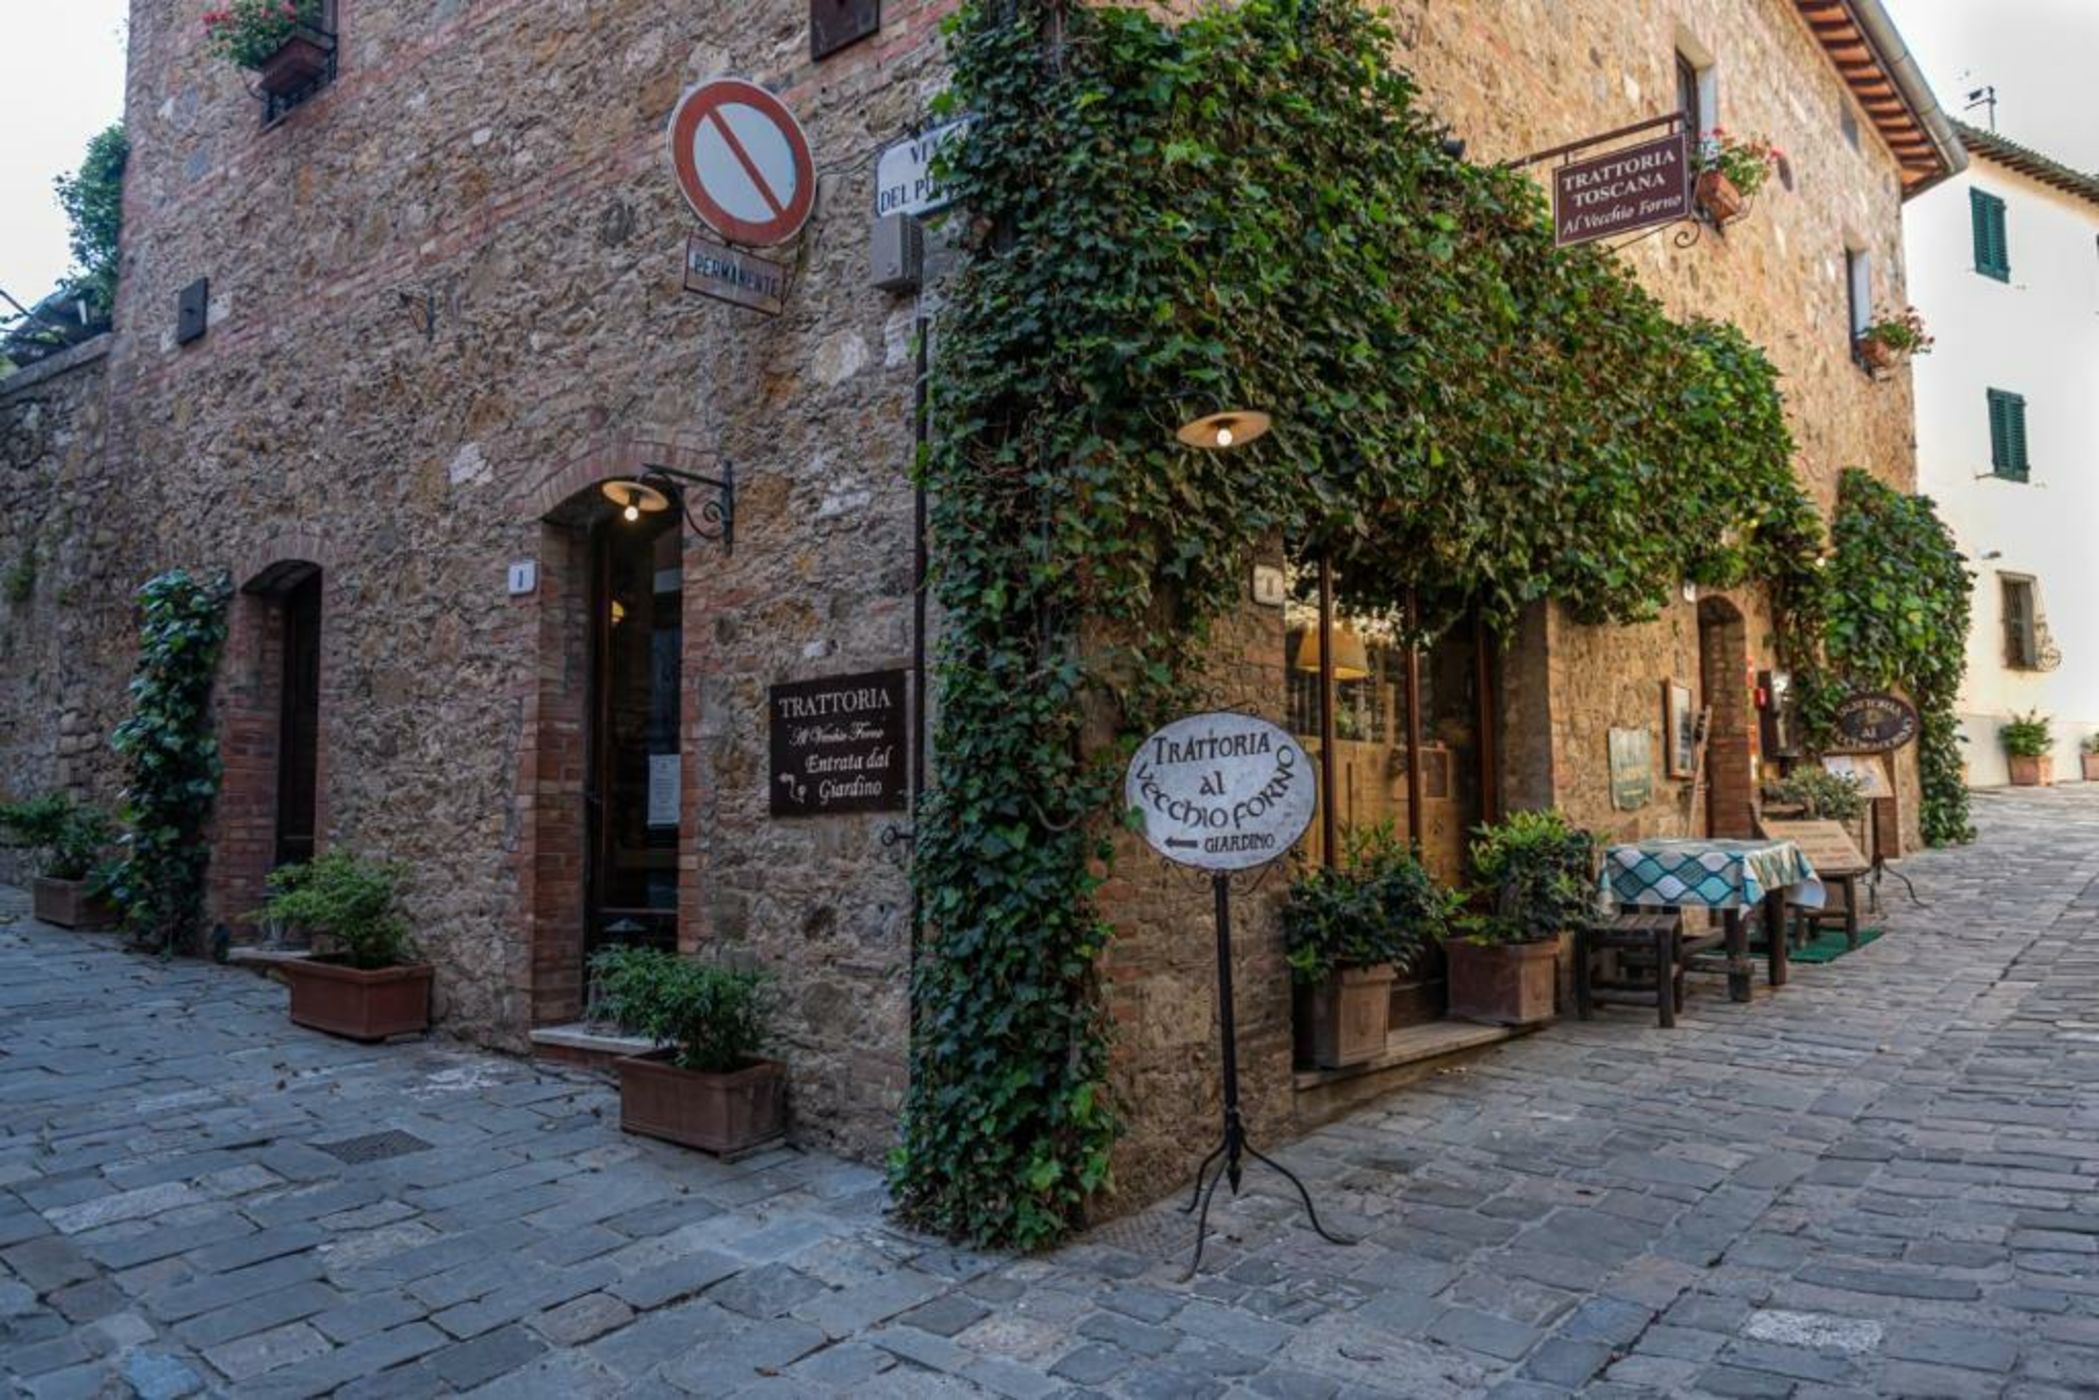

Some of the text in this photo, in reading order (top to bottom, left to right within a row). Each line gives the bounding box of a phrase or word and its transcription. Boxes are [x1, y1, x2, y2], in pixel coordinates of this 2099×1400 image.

[1563, 150, 1675, 191] TRATTORIA
[881, 184, 909, 213] DEL
[1574, 172, 1666, 208] TOSCANA
[1562, 194, 1682, 236] Al Vecchio Forno
[694, 254, 777, 298] PERMANENTE
[778, 688, 891, 718] TRATTORIA
[805, 745, 893, 774] Entrata dal
[1153, 730, 1270, 765] TRATTORIA
[819, 774, 882, 805] Giardino
[1204, 833, 1275, 853] GIARDINO
